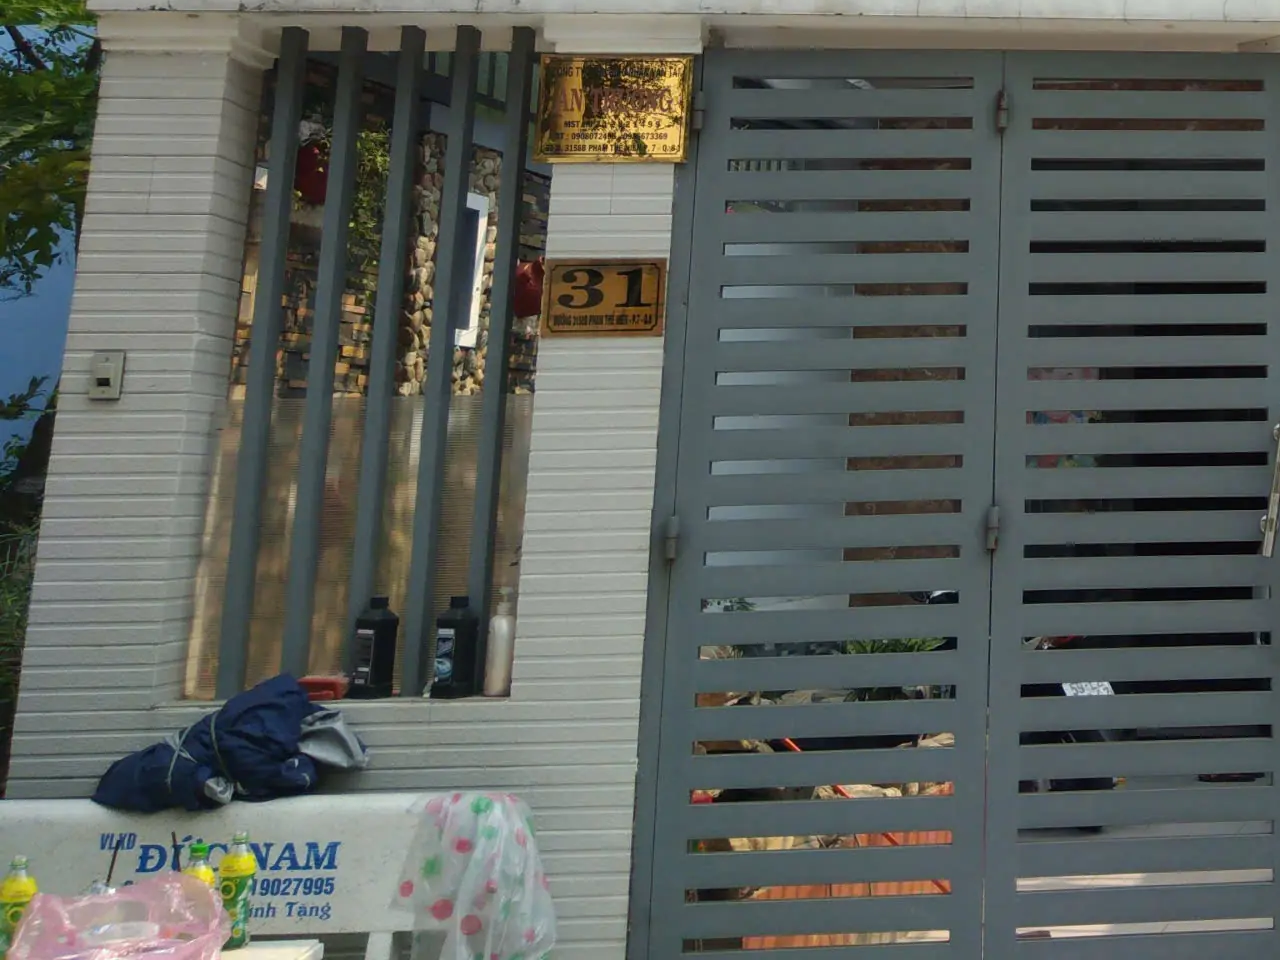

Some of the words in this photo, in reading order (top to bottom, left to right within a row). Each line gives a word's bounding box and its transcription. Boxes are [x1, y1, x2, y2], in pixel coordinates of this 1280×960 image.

[557, 268, 652, 309] 31
[100, 833, 137, 850] VLXD
[249, 842, 341, 872] NAM
[250, 877, 335, 896] 19027995
